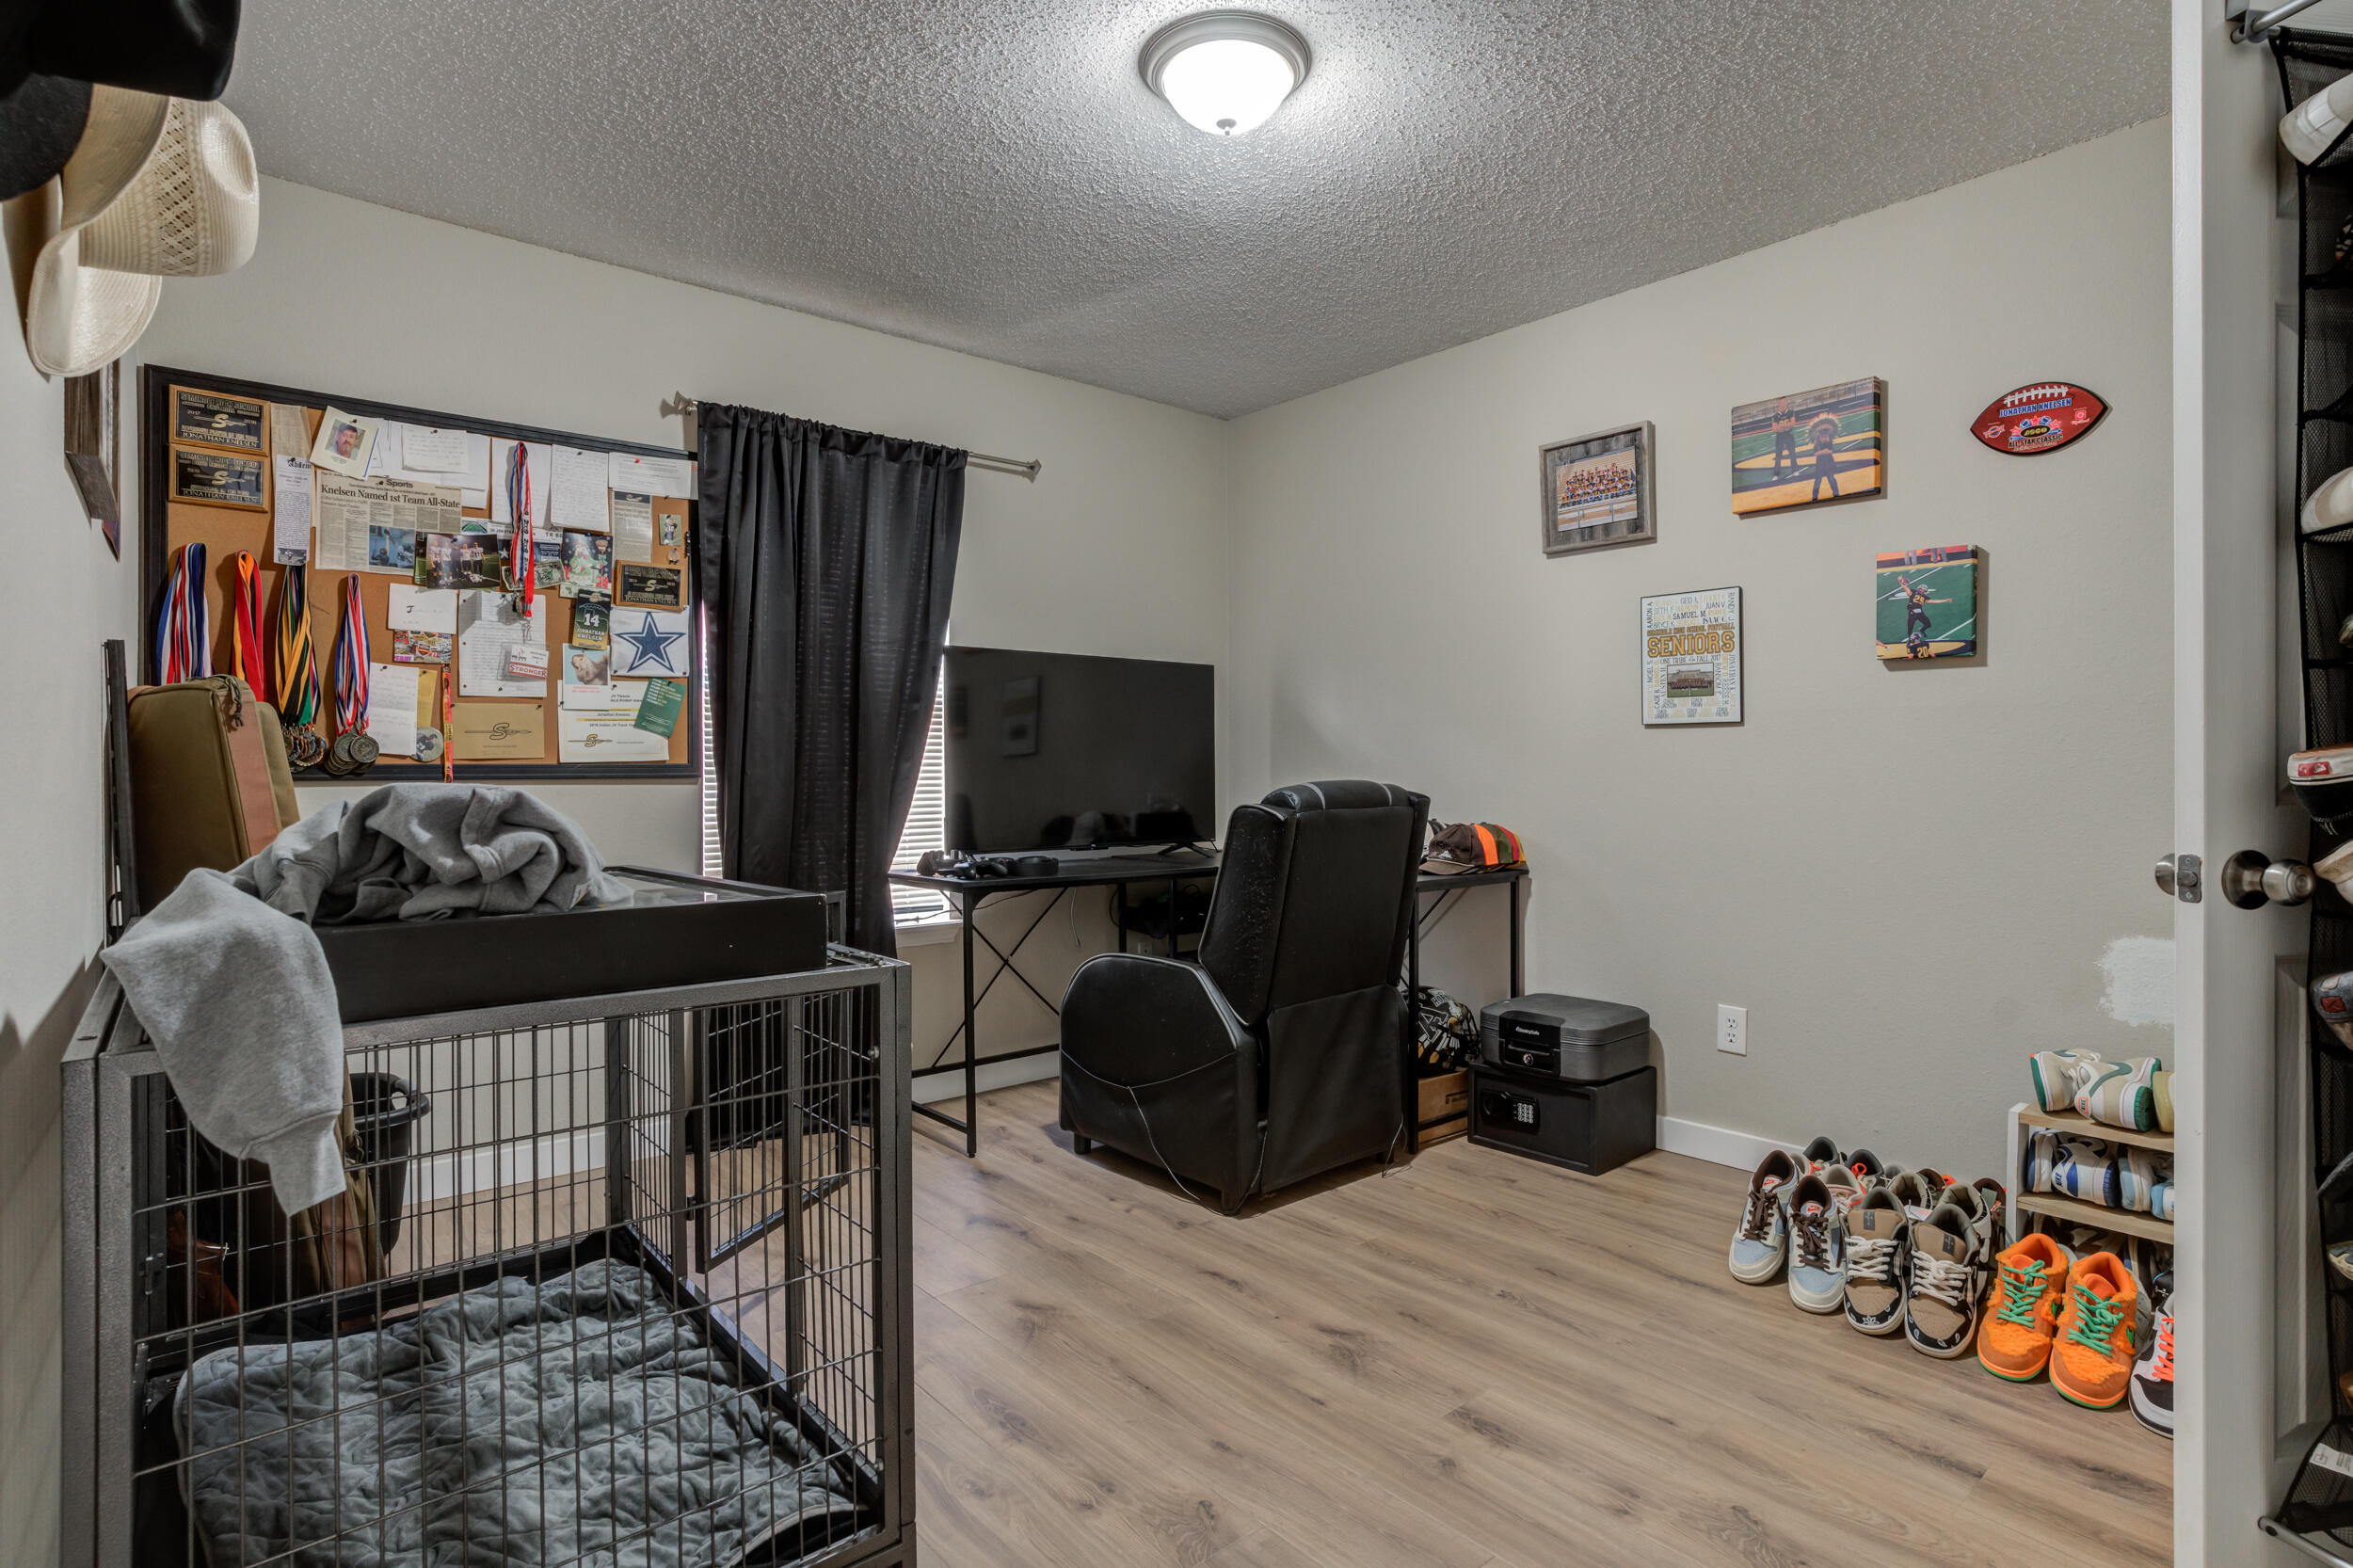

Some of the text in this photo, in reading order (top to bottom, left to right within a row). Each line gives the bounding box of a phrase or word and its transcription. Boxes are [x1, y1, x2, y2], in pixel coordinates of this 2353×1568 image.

[1999, 398, 2072, 418] JONATHAN KNELSEN
[183, 432, 225, 444] JONATHAN
[2037, 434, 2064, 445] CLASSIC
[386, 478, 414, 488] Sports
[321, 483, 356, 497] Knelsen
[358, 489, 388, 501] Named
[390, 493, 400, 503] 1st
[402, 494, 425, 505] Team
[426, 496, 460, 508] All-State
[584, 613, 600, 626] 14
[1673, 611, 1698, 620] SAMUEL
[1686, 625, 1706, 633] SCHOOL
[1707, 622, 1735, 631] FOOTBALL
[1648, 631, 1735, 658] SENIORS
[1918, 646, 1929, 658] 20
[510, 664, 547, 679] STRONGER
